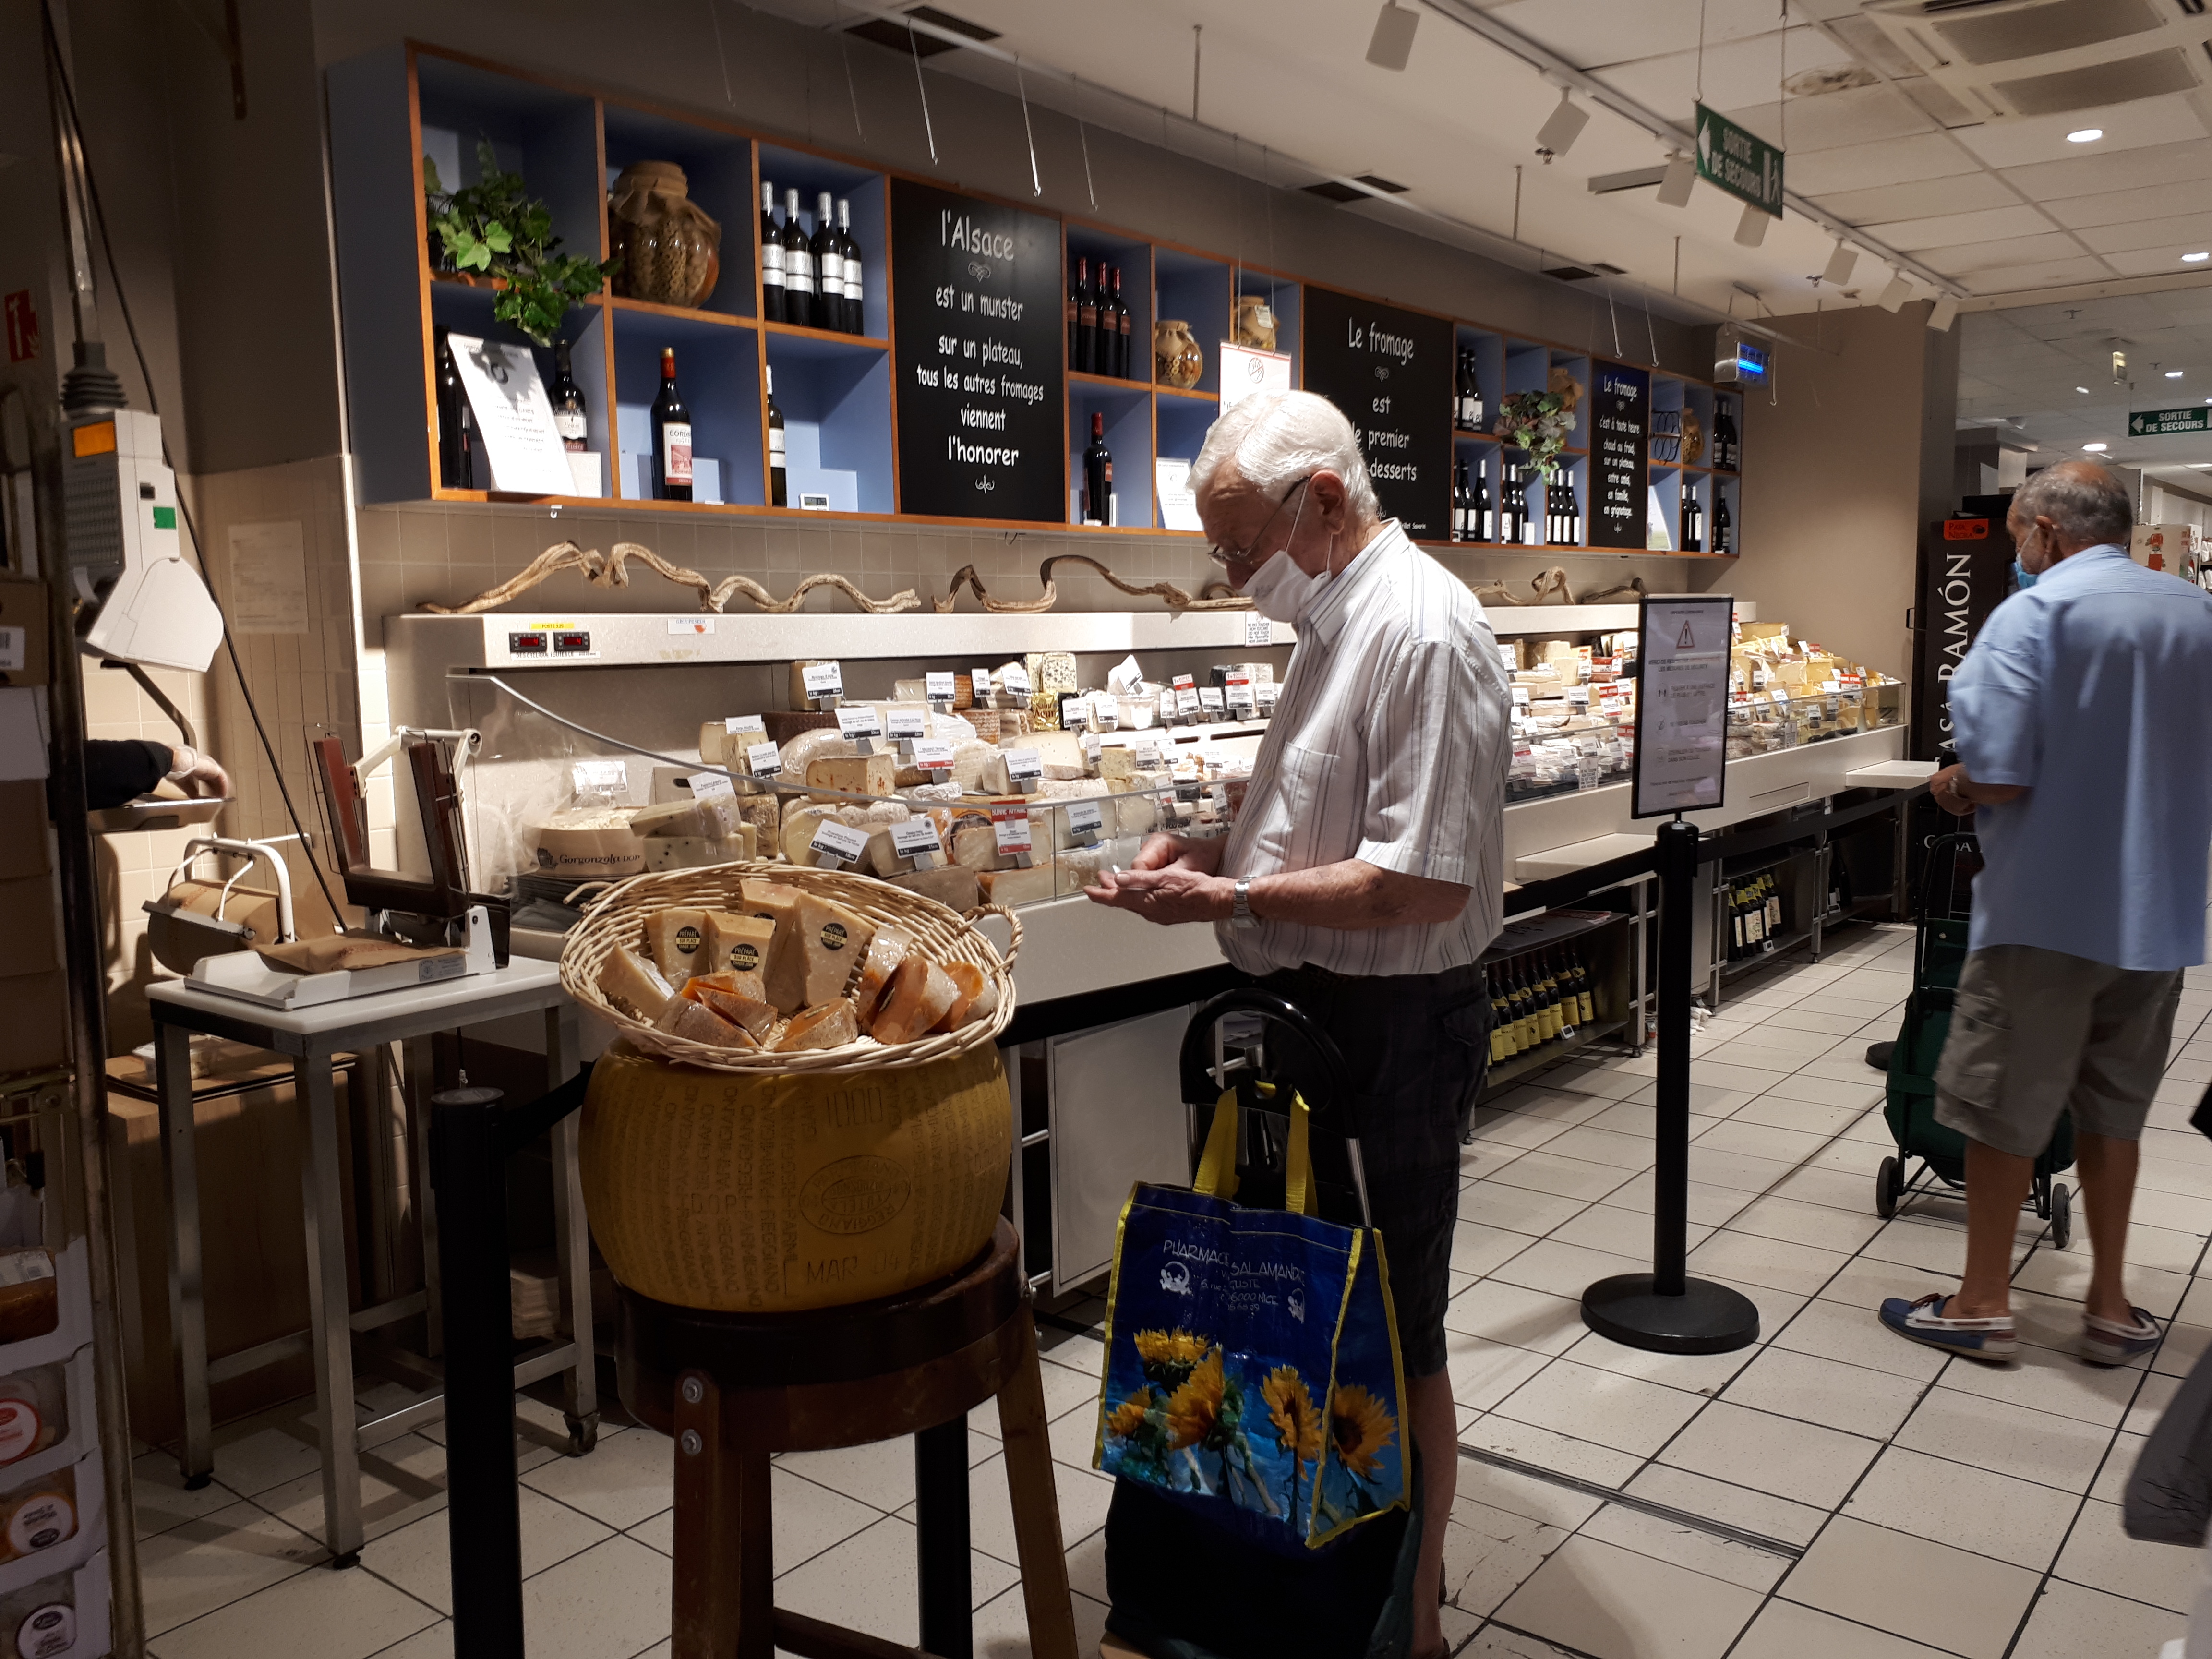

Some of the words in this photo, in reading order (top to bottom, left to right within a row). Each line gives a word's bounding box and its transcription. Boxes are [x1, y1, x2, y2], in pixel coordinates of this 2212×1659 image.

[942, 209, 1014, 261] l'Alsace
[936, 283, 955, 309] est
[961, 290, 974, 313] un
[980, 295, 1023, 322] munster
[1348, 316, 1363, 349] Le
[1369, 321, 1414, 366] fromage
[938, 334, 958, 356] sur
[963, 339, 976, 359] un
[982, 336, 1023, 370] plateau,
[916, 363, 939, 387] tous
[944, 364, 959, 390] les
[963, 372, 996, 395] autres
[1001, 373, 1044, 406] fromages
[1603, 375, 1612, 393] Le
[1614, 376, 1638, 402] fromage
[1372, 396, 1391, 414] est
[2159, 410, 2192, 421] SORTIE
[960, 402, 1006, 431] viennent
[1616, 419, 1627, 432] toute
[1628, 419, 1641, 434] heure
[2146, 423, 2158, 432] DE
[2161, 420, 2204, 432] SECOURS
[1352, 421, 1362, 444] le
[1368, 428, 1410, 451] premier
[1603, 437, 1616, 451] chaud
[1617, 443, 1623, 453] ou
[948, 434, 1019, 467] l'honorer
[1370, 457, 1417, 481] desserts
[1608, 472, 1620, 484] entre
[1936, 553, 1972, 683] RAMÓN
[1034, 709, 1054, 719] Agur
[559, 854, 620, 865] Gorgonzola
[825, 925, 845, 936] PRÉPARÉ
[734, 947, 756, 956] PRÉPARÉ
[1259, 1291, 1279, 1305] NICE
